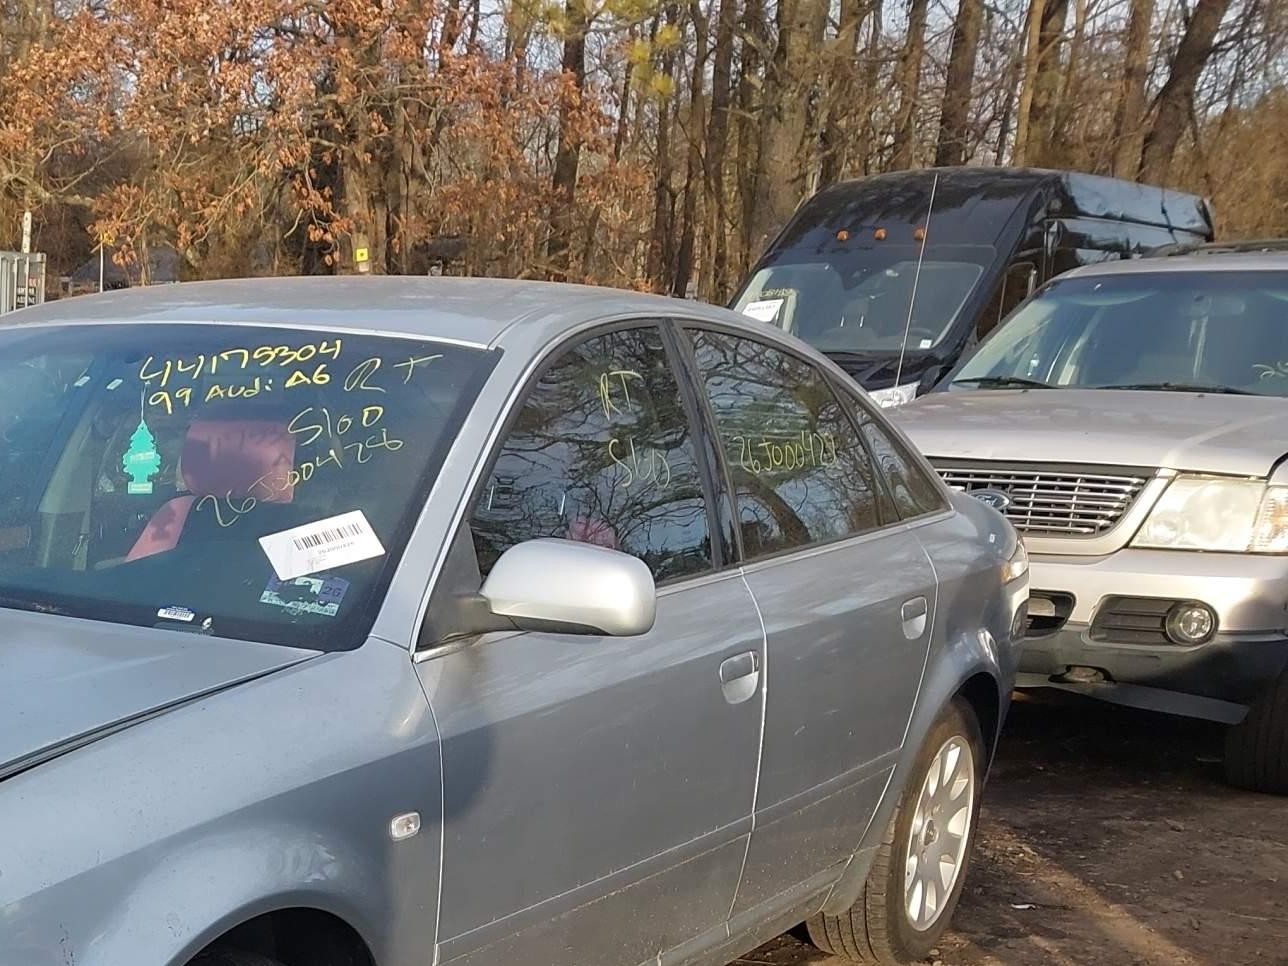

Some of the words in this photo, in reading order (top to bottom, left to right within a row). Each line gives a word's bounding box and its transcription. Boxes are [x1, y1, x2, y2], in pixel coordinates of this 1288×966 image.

[139, 339, 342, 387] 44175304
[149, 387, 192, 414] 99
[284, 364, 330, 388] A6
